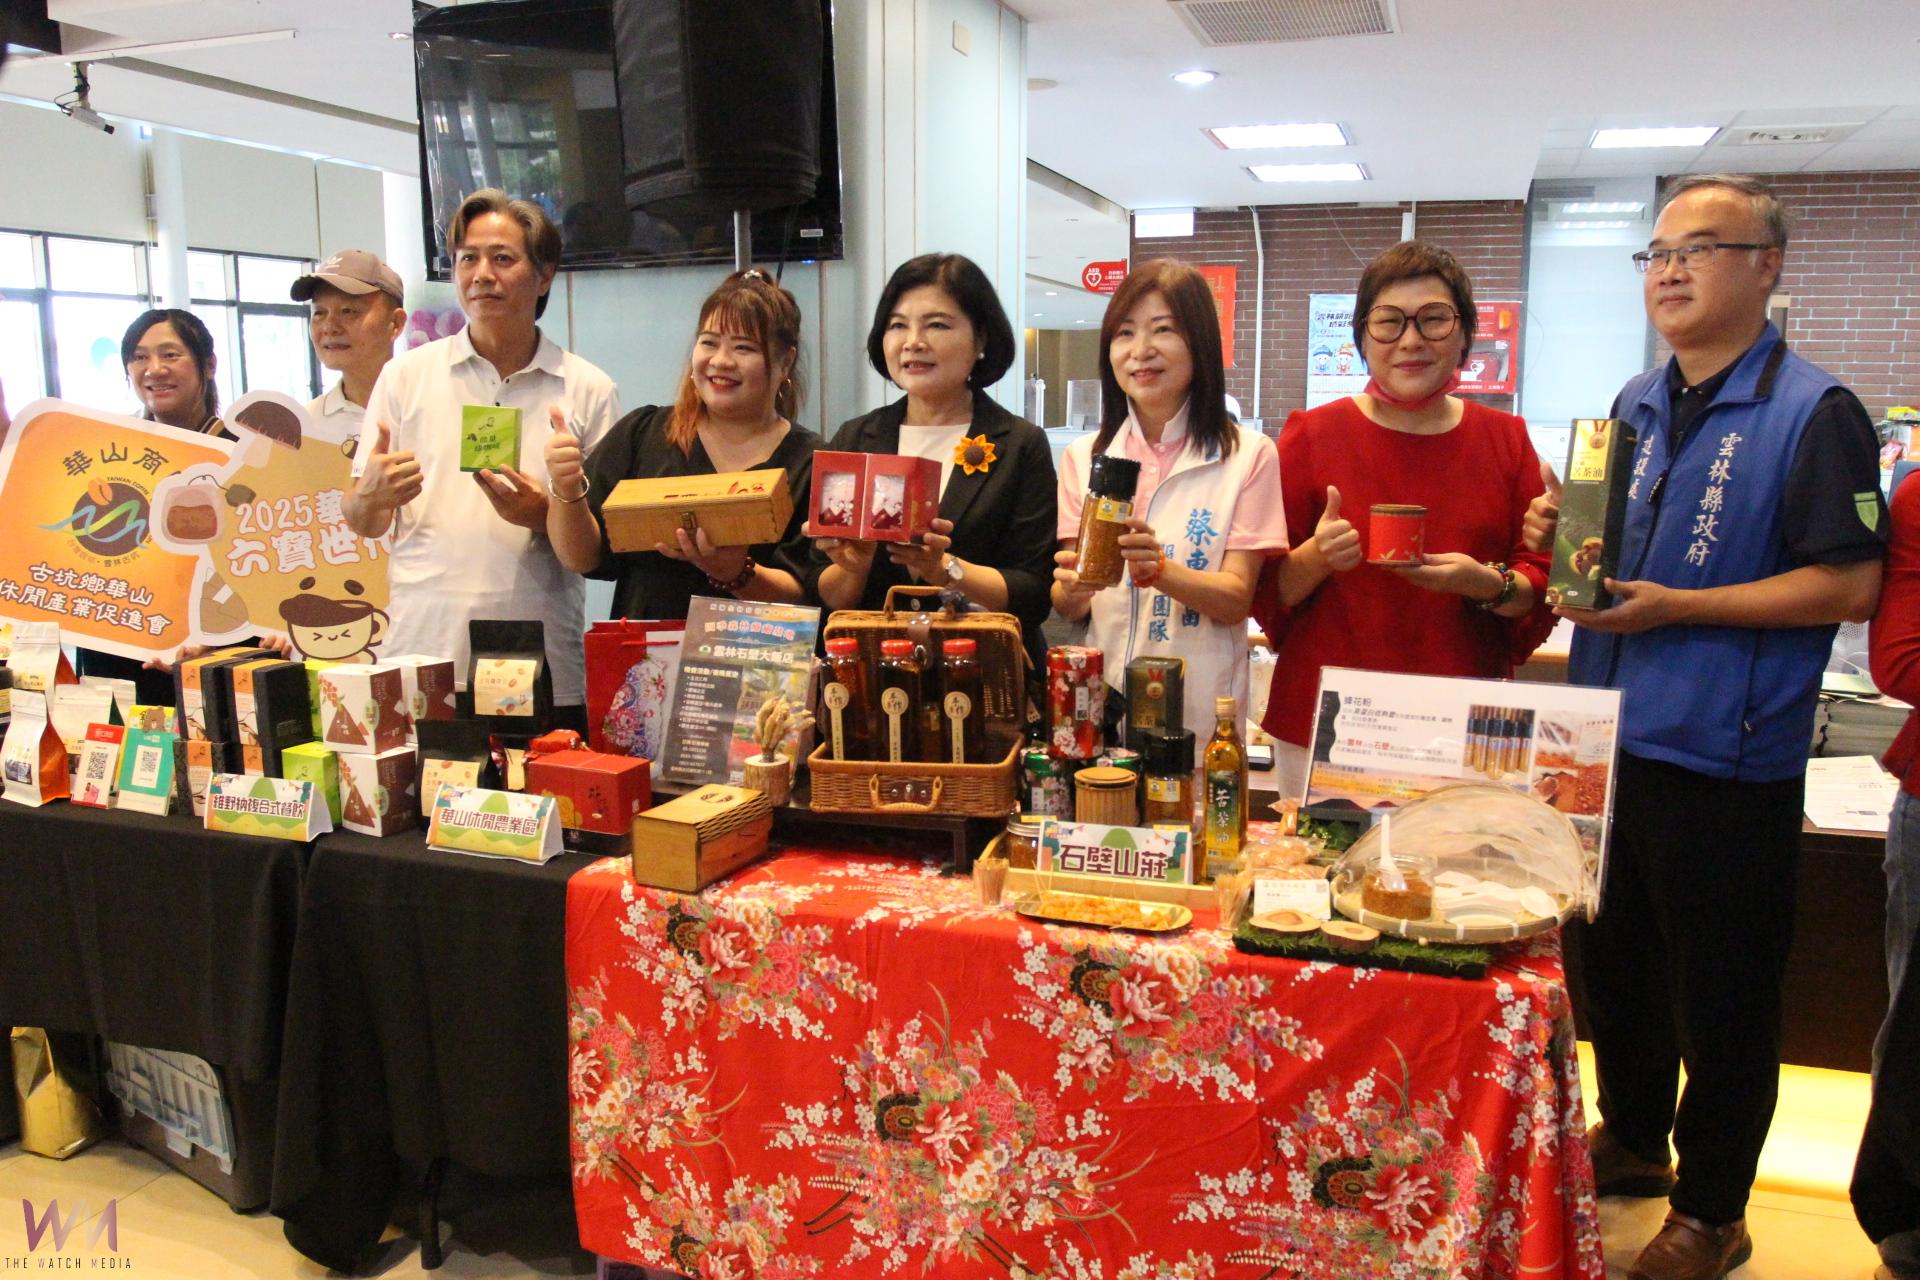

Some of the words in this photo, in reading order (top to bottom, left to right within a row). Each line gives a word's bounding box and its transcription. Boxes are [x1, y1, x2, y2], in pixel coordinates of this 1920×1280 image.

[62, 442, 181, 476] 華山商
[1685, 432, 1743, 567] 雲林縣政府
[29, 562, 153, 606] 古坑鄉華山
[0, 579, 173, 636] 休閒產業促進會
[1344, 696, 1372, 707] 蜂花粉
[213, 794, 304, 818] 維野納複合式餐飲
[440, 808, 538, 836] 華山休閒農業區
[1215, 787, 1231, 843] 苦茶油
[1059, 843, 1169, 880] 石壁山莊
